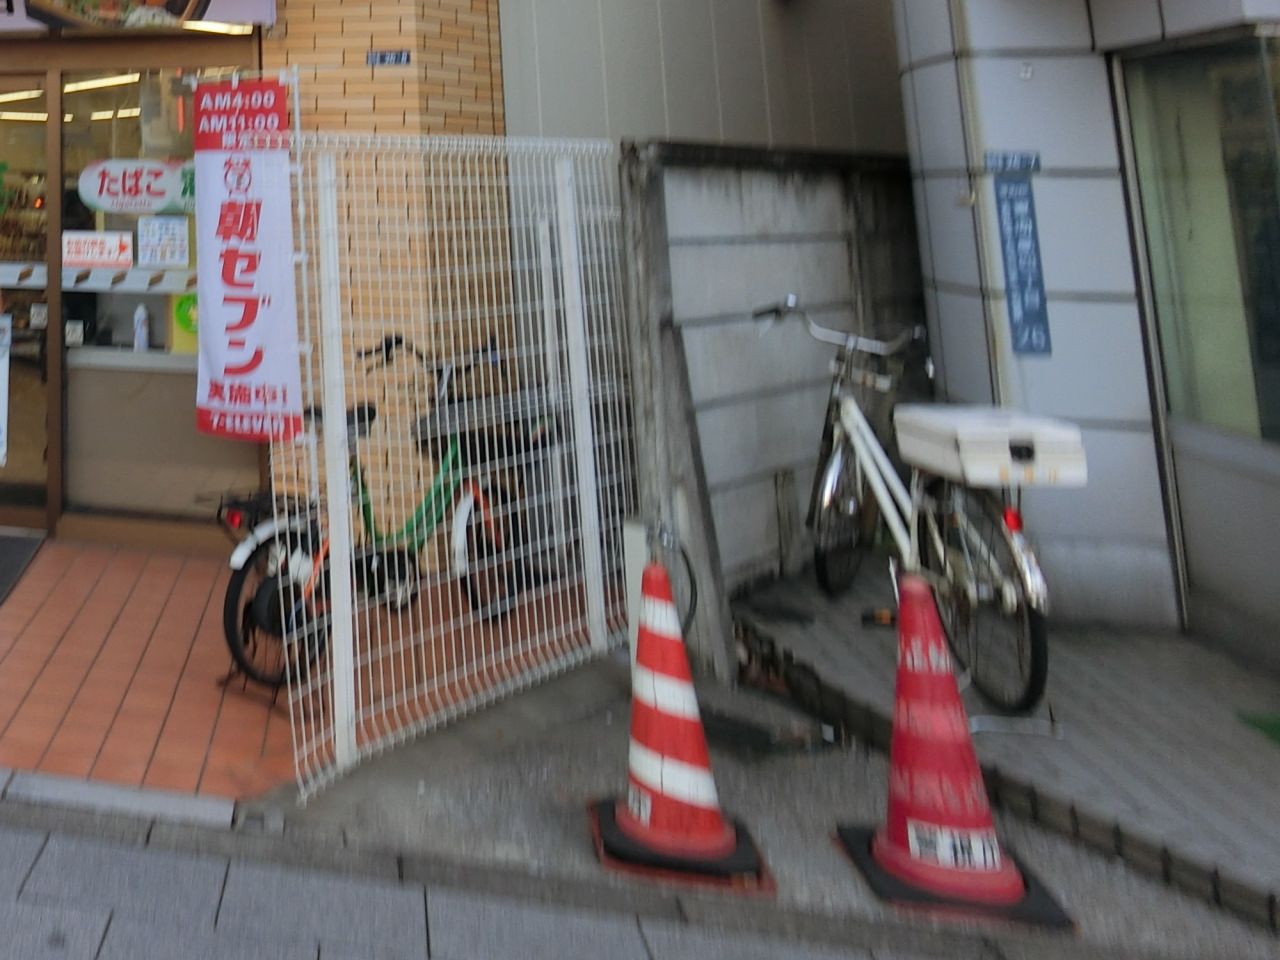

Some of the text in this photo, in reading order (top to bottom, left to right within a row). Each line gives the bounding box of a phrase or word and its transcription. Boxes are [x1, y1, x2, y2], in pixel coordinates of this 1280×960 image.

[200, 90, 276, 111] AM4:00
[199, 112, 280, 135] AM11:00
[98, 167, 166, 198] たばこ
[216, 200, 271, 377] 朝セブン
